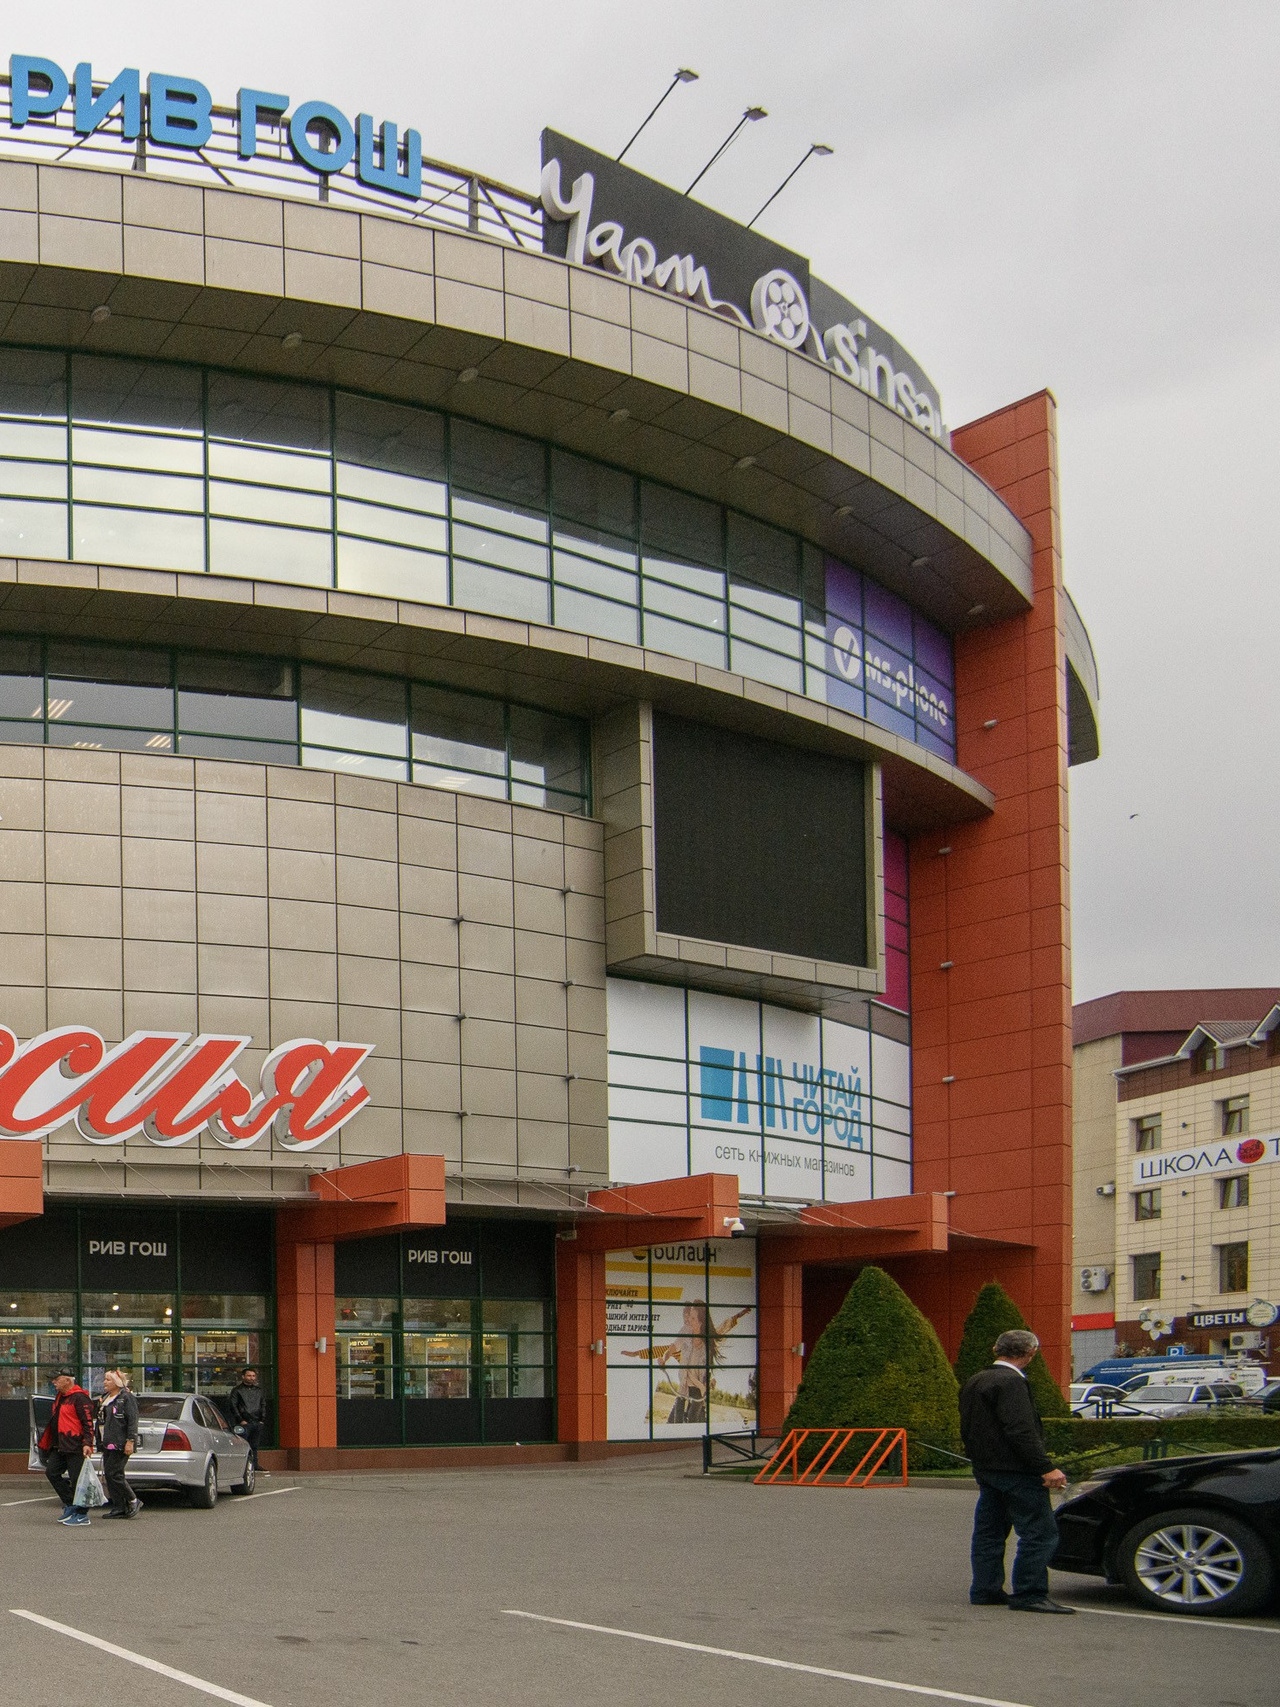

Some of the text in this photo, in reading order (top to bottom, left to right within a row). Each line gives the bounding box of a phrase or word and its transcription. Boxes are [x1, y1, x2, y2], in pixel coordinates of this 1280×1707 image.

[9, 54, 422, 202] РИВ ГОШ
[792, 1062, 862, 1111] ЧИТАЙ
[793, 1097, 863, 1152] ГОРОД
[714, 1145, 855, 1177] сеть книжных магазинов
[1140, 1147, 1233, 1179] ШКОЛА
[89, 1240, 167, 1257] РИВ ГОШ
[408, 1249, 473, 1265] РИВ ГОШ
[1193, 1312, 1245, 1327] ЦВЕТЫ
